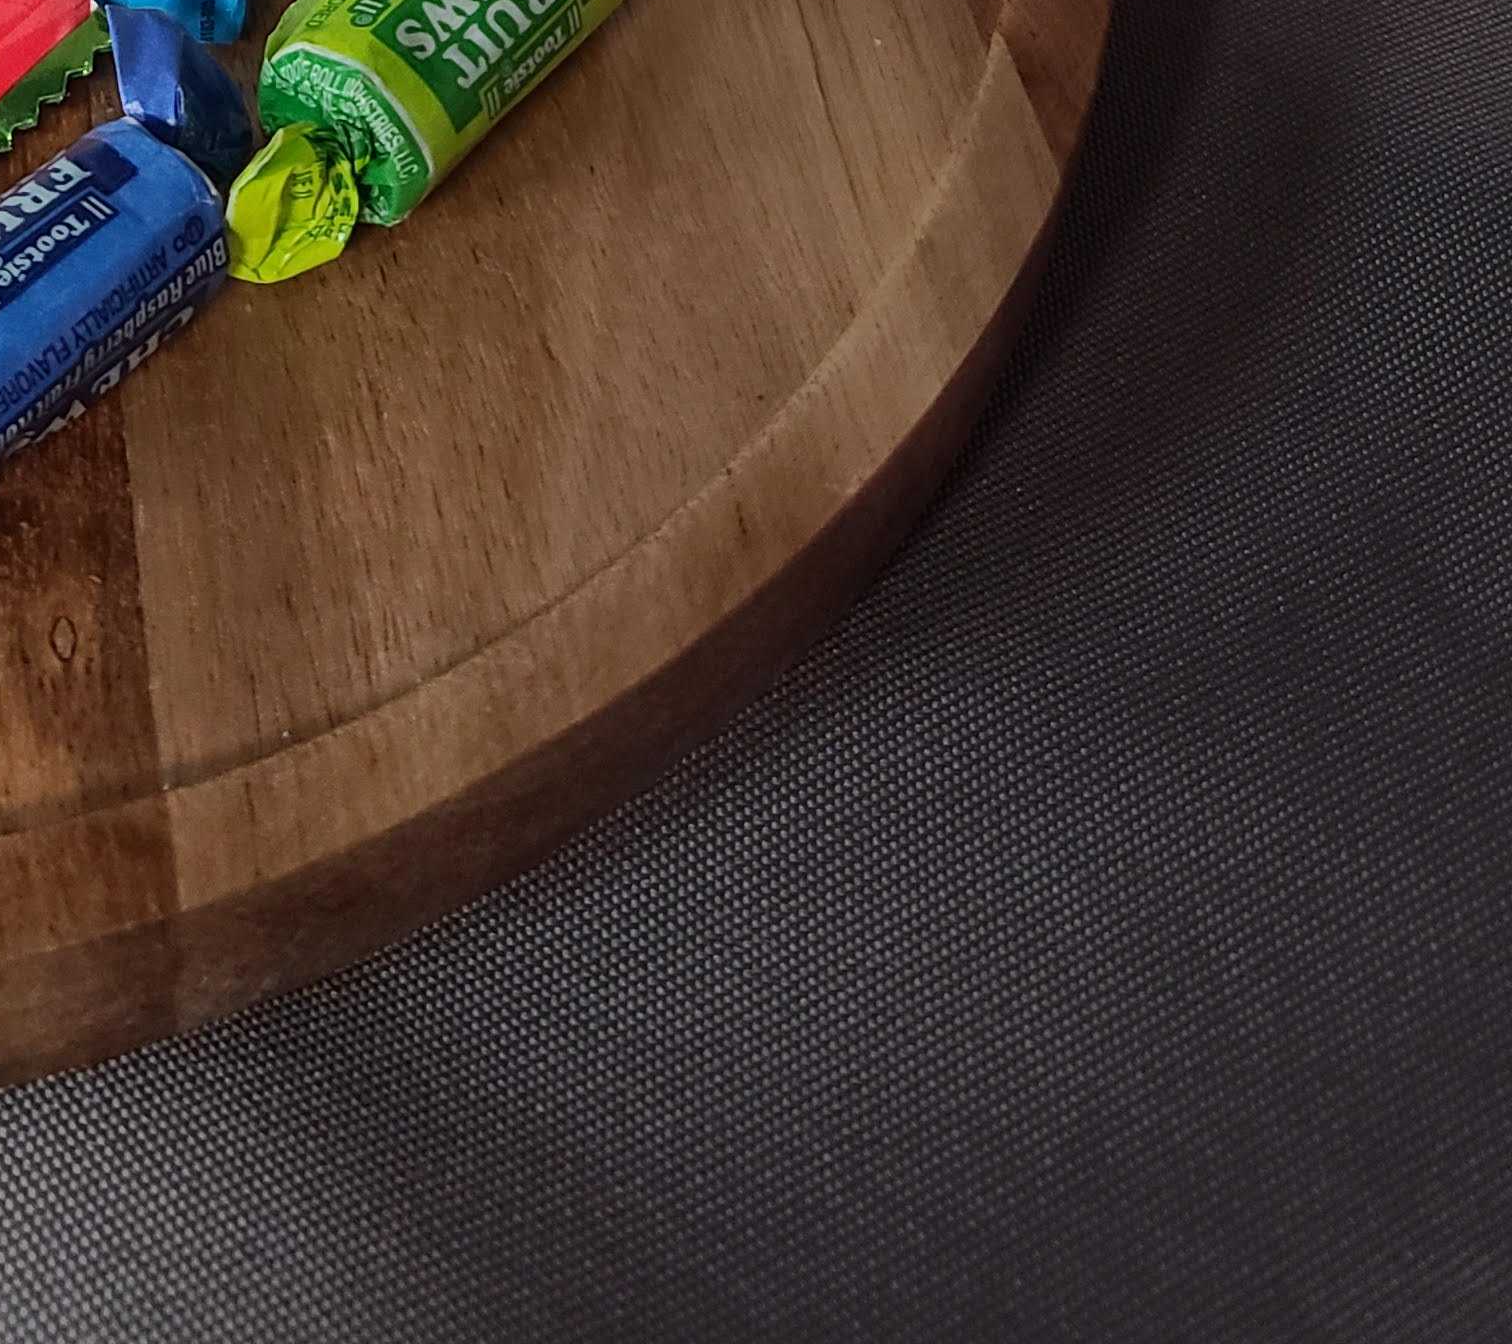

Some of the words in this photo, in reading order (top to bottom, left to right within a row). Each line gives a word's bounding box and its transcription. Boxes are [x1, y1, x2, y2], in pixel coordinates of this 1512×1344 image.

[503, 25, 568, 94] Tootsie
[71, 244, 169, 345] ARTIFICIALLY
[185, 236, 228, 287] Blue
[83, 275, 185, 369] Raspberry
